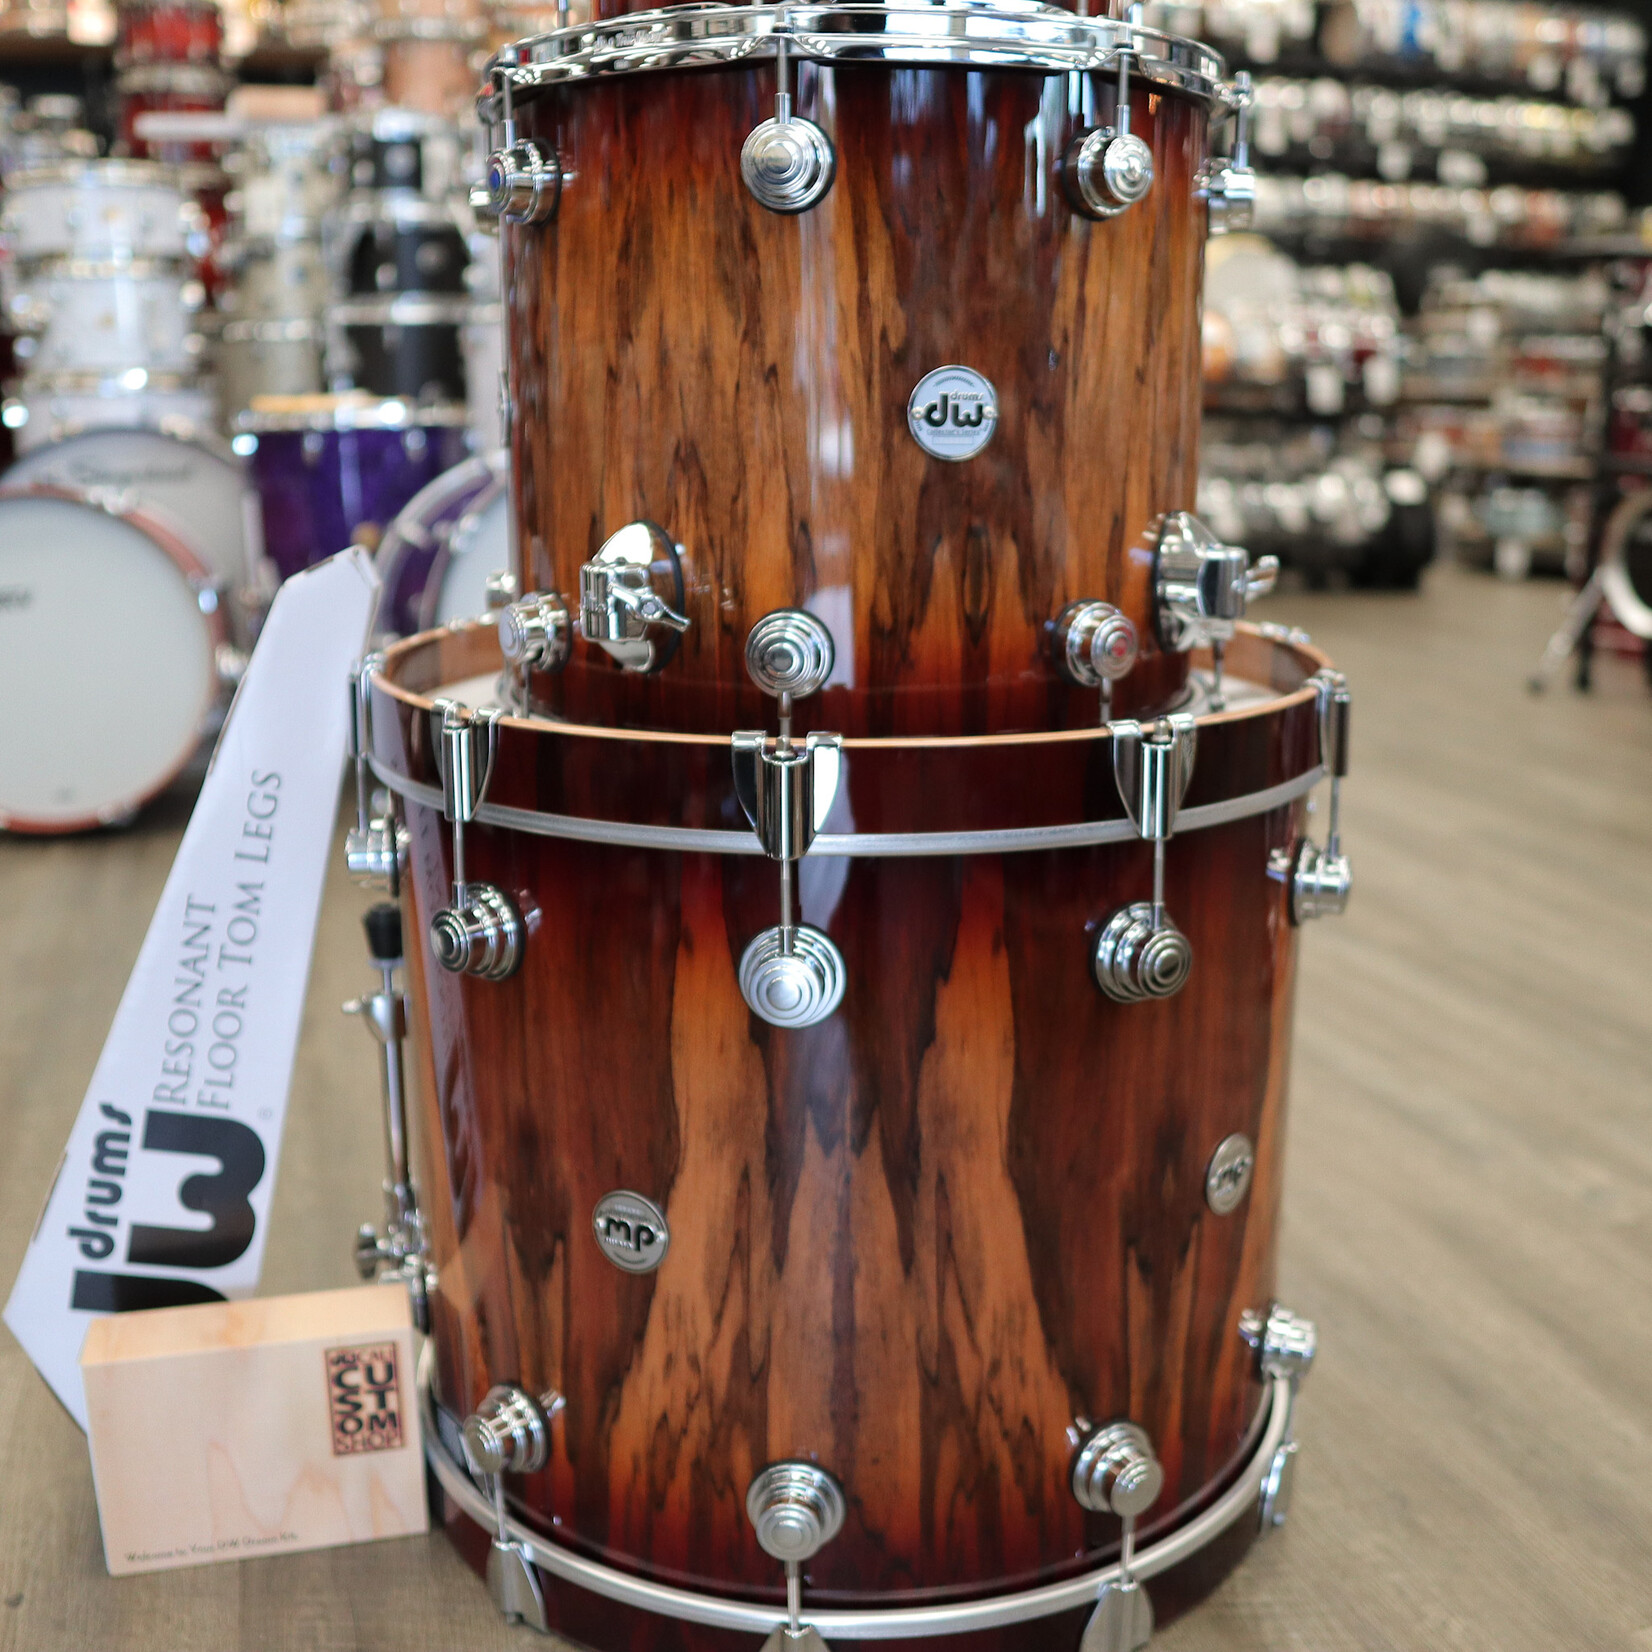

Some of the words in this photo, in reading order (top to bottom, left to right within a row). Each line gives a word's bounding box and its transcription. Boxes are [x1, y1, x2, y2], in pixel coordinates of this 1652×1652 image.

[924, 391, 984, 428] dw
[234, 769, 283, 865] LEGS
[218, 881, 265, 970] TOM
[152, 893, 216, 1106] RESONANT
[196, 985, 248, 1111] FLOOR
[67, 1101, 133, 1260] drums
